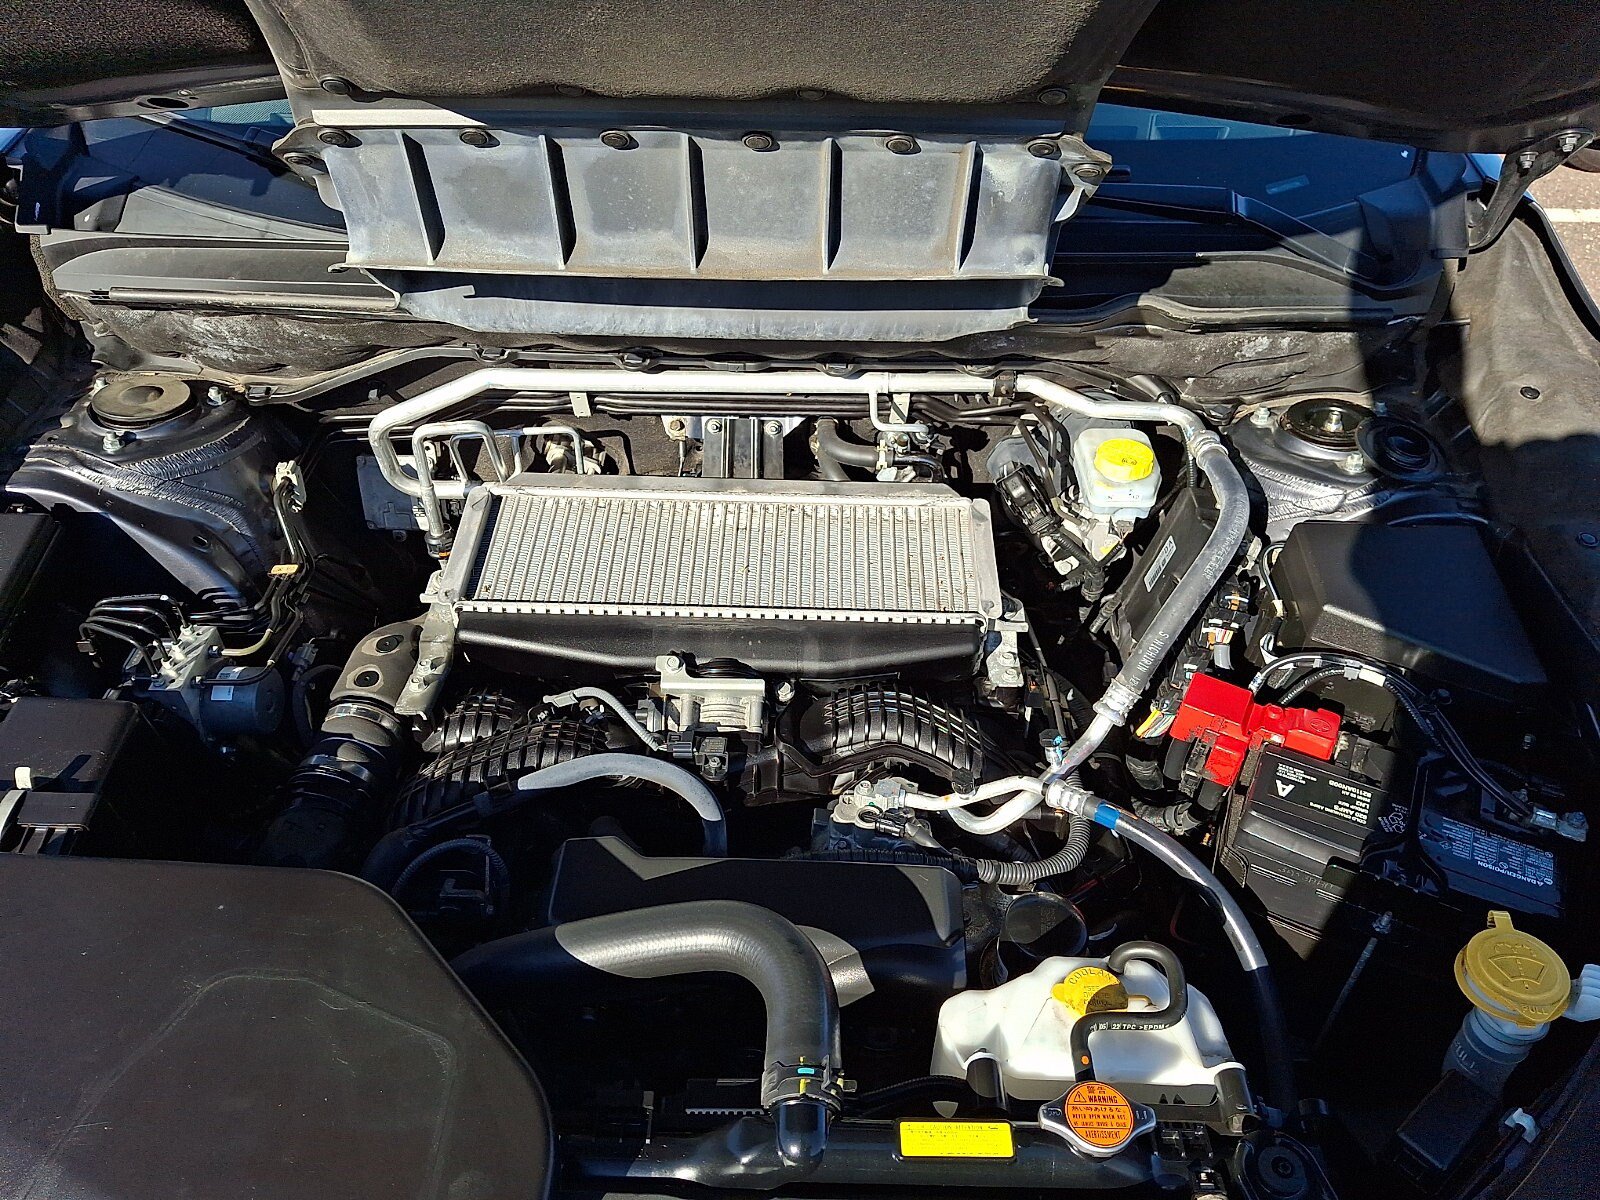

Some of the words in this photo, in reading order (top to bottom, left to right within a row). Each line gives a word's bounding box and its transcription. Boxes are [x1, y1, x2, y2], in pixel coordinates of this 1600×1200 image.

[1137, 638, 1165, 673] NICHIRIN
[1333, 804, 1355, 816] AMPS
[1352, 815, 1367, 825] COLD
[1521, 1004, 1548, 1015] PULL
[1087, 1095, 1118, 1103] WARNING
